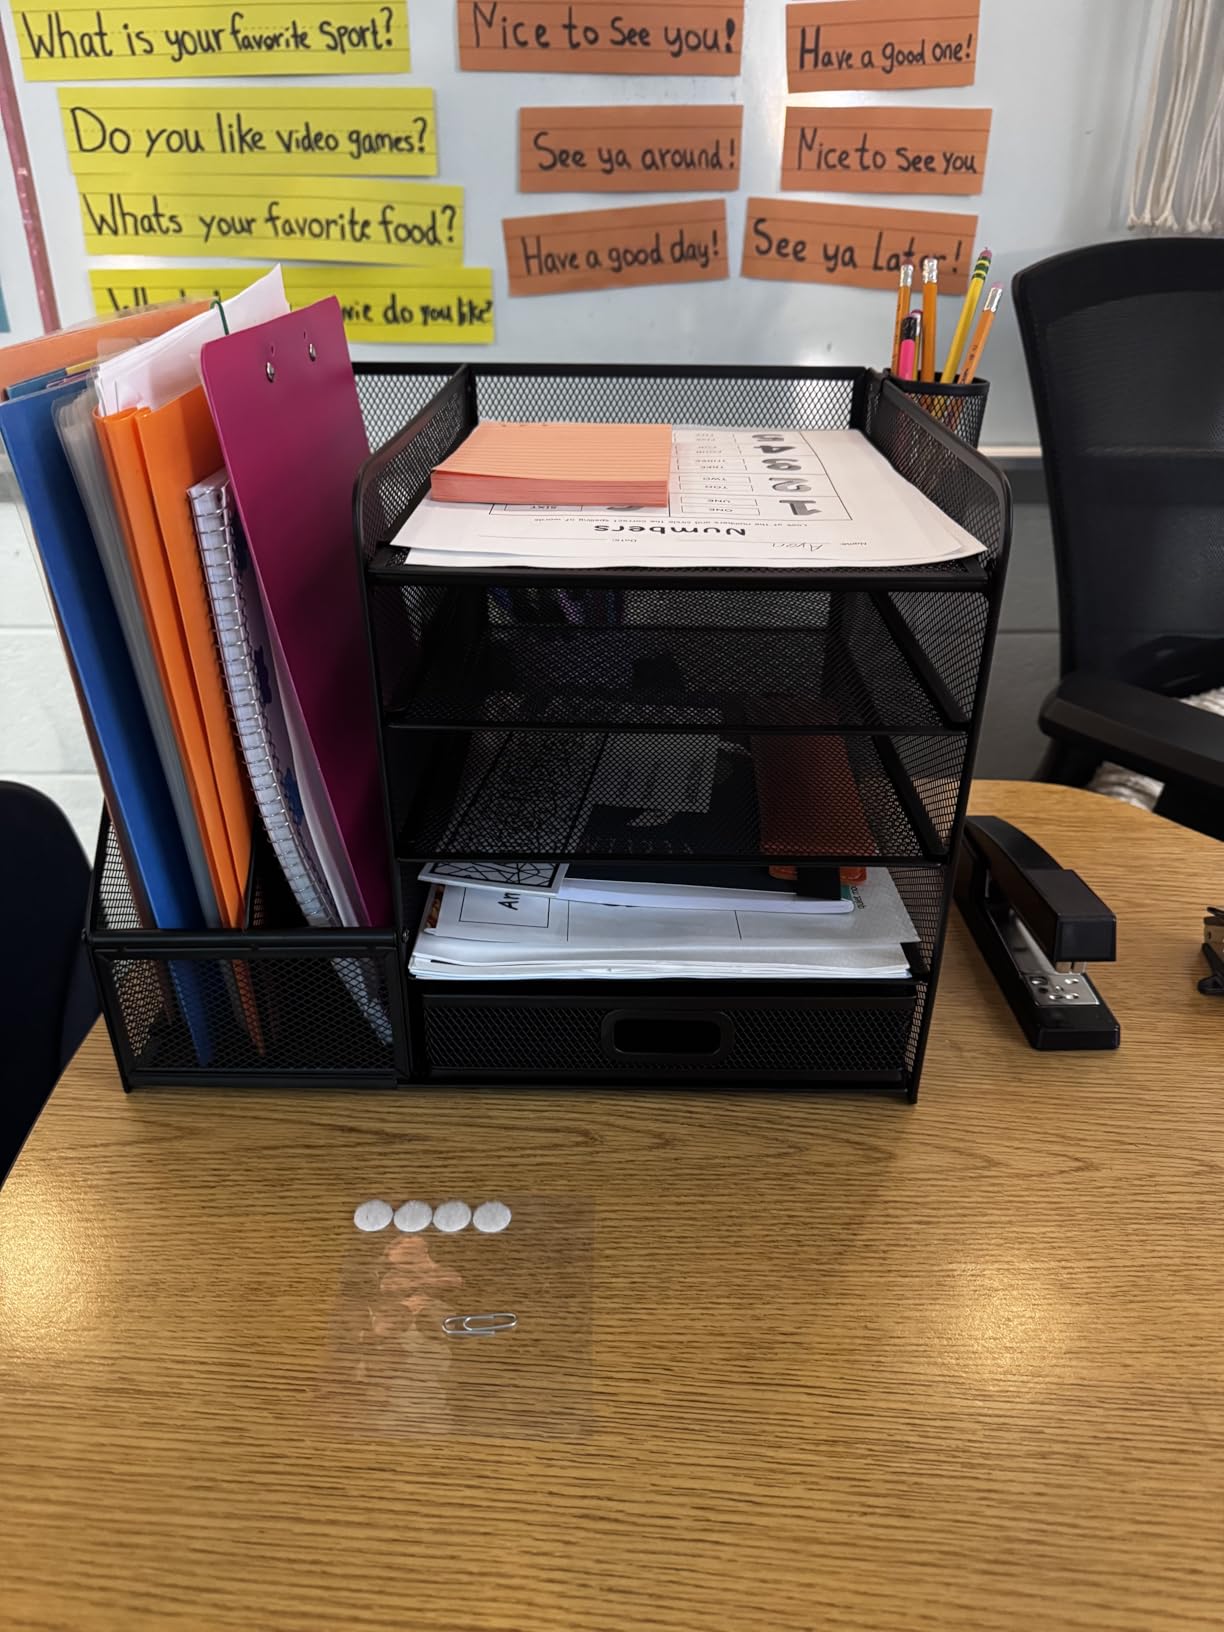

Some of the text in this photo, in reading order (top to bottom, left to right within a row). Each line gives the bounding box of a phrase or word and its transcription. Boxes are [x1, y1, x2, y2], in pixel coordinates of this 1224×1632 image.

[22, 7, 394, 62] What is your favorite Sport?
[473, 1, 738, 58] Nice to See you!
[799, 27, 973, 74] Have a good one!
[70, 106, 427, 159] Do you like video games?
[534, 131, 738, 175] See ya around!
[797, 128, 976, 175] Nice to See you
[83, 193, 458, 246] Whats your favorite food?
[522, 230, 719, 276] Have a good day!
[753, 218, 807, 260] See
[822, 242, 857, 270] ya
[383, 292, 414, 325] do
[419, 304, 453, 326] you
[768, 478, 812, 492] 2
[779, 500, 822, 516] 1
[594, 525, 746, 536] Numbers
